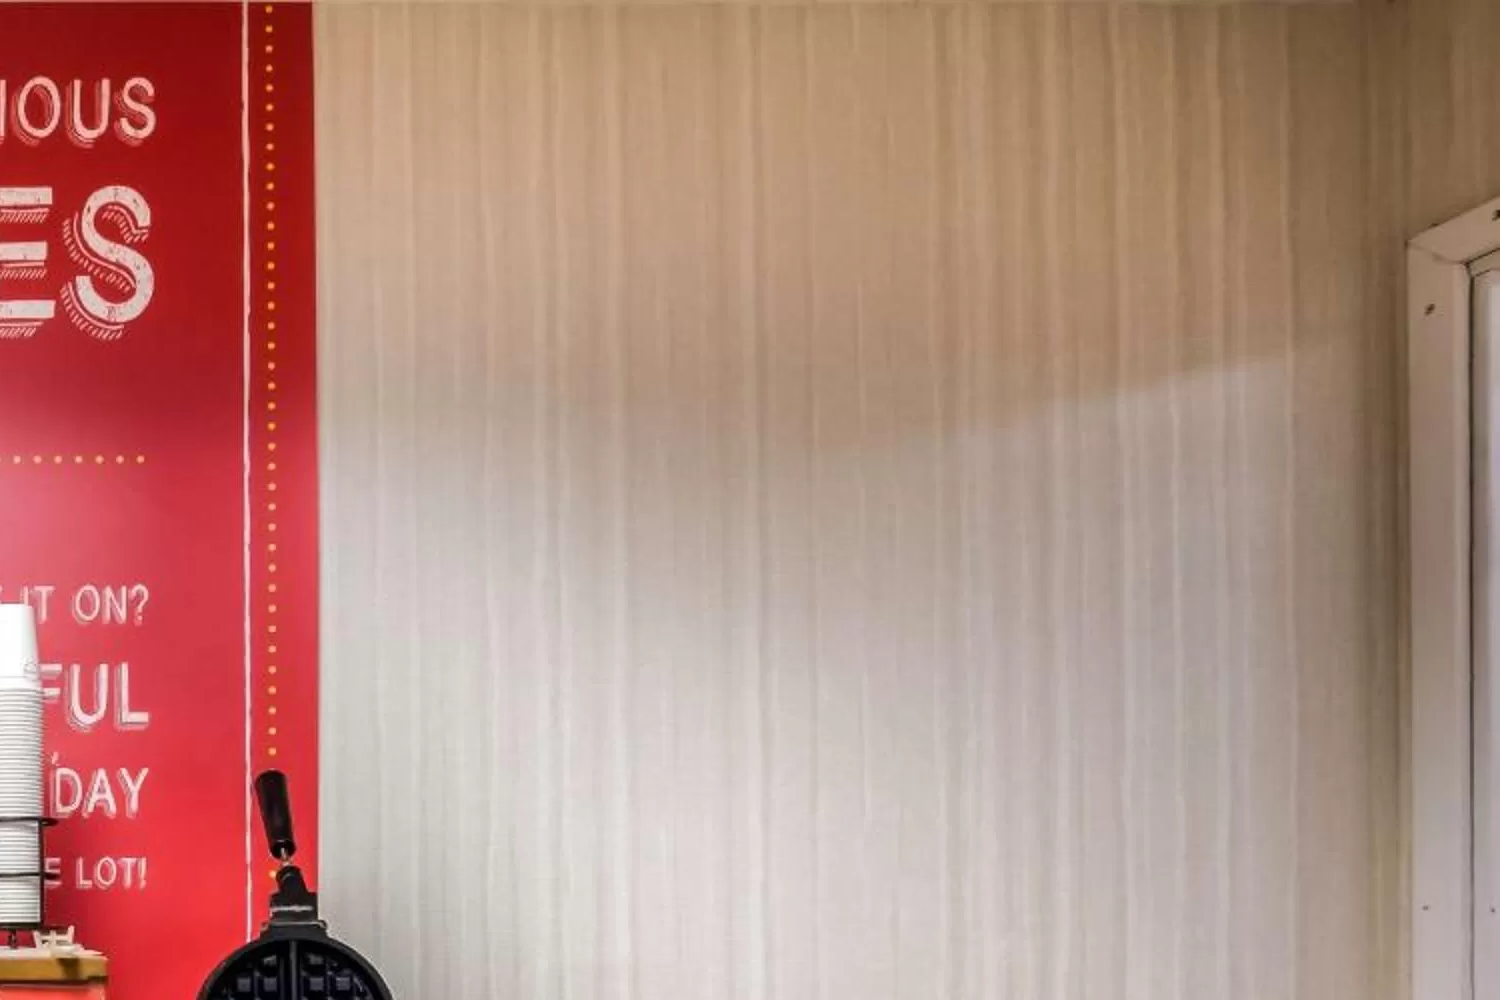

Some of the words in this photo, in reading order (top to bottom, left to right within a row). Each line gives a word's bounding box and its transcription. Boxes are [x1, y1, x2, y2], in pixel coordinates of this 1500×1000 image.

[72, 584, 150, 626] ON?
[50, 768, 150, 819] DAY
[75, 857, 149, 889] LOT!
